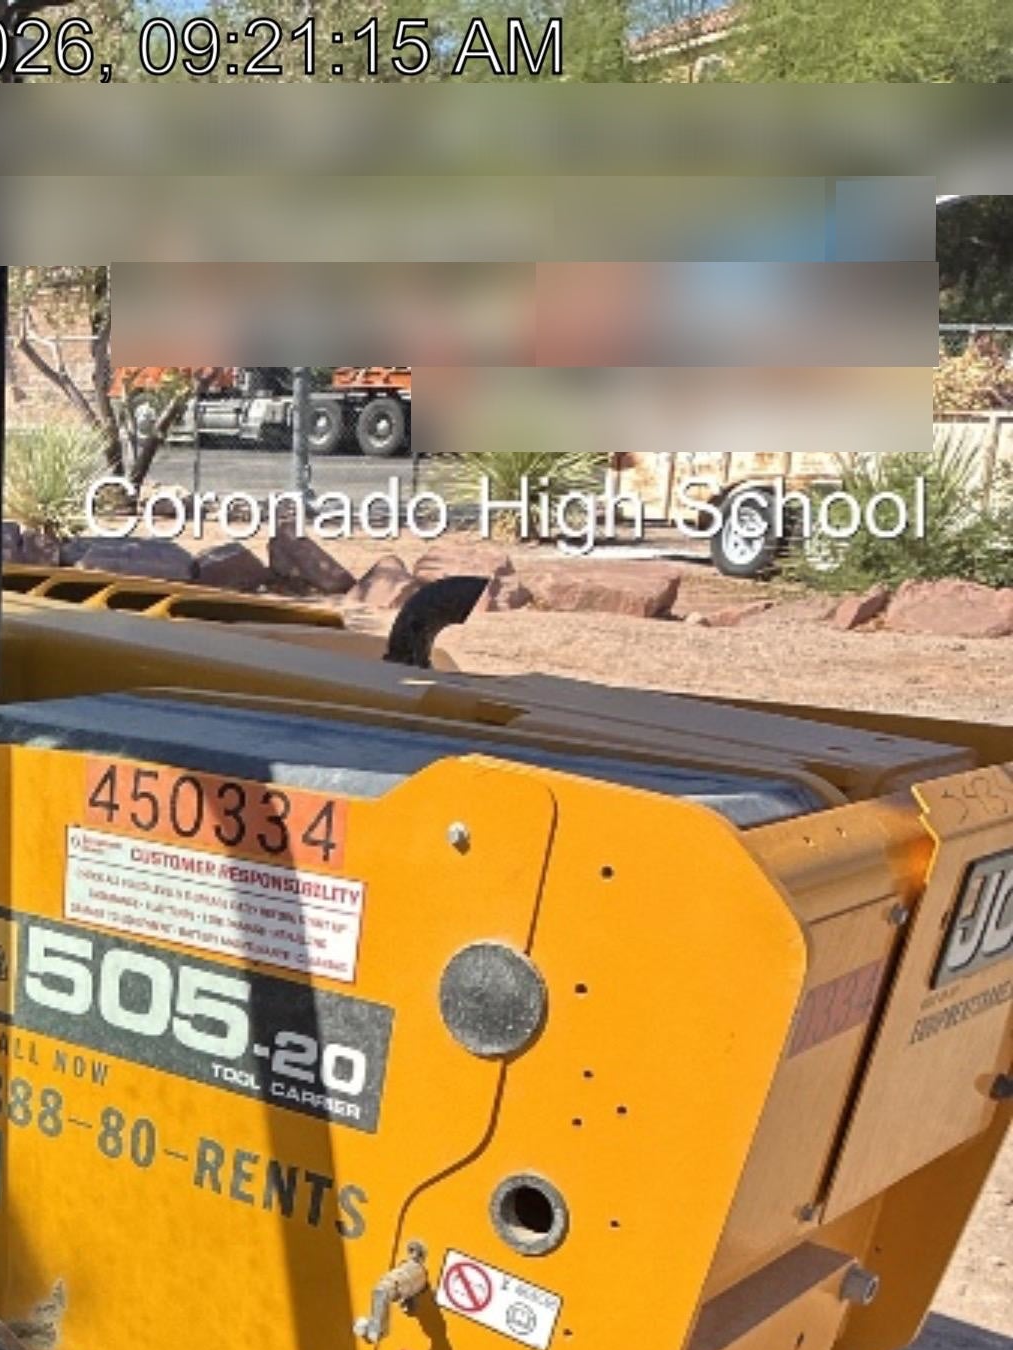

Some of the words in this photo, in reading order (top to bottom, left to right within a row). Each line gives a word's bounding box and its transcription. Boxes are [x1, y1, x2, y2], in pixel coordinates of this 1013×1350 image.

[89, 764, 336, 862] 450334
[130, 847, 216, 875] CUSTOMER
[218, 863, 361, 904] RESPONSIBILITY
[53, 1049, 111, 1087] NOW
[213, 1062, 261, 1091] TOOL
[271, 1081, 362, 1121] CARRIER
